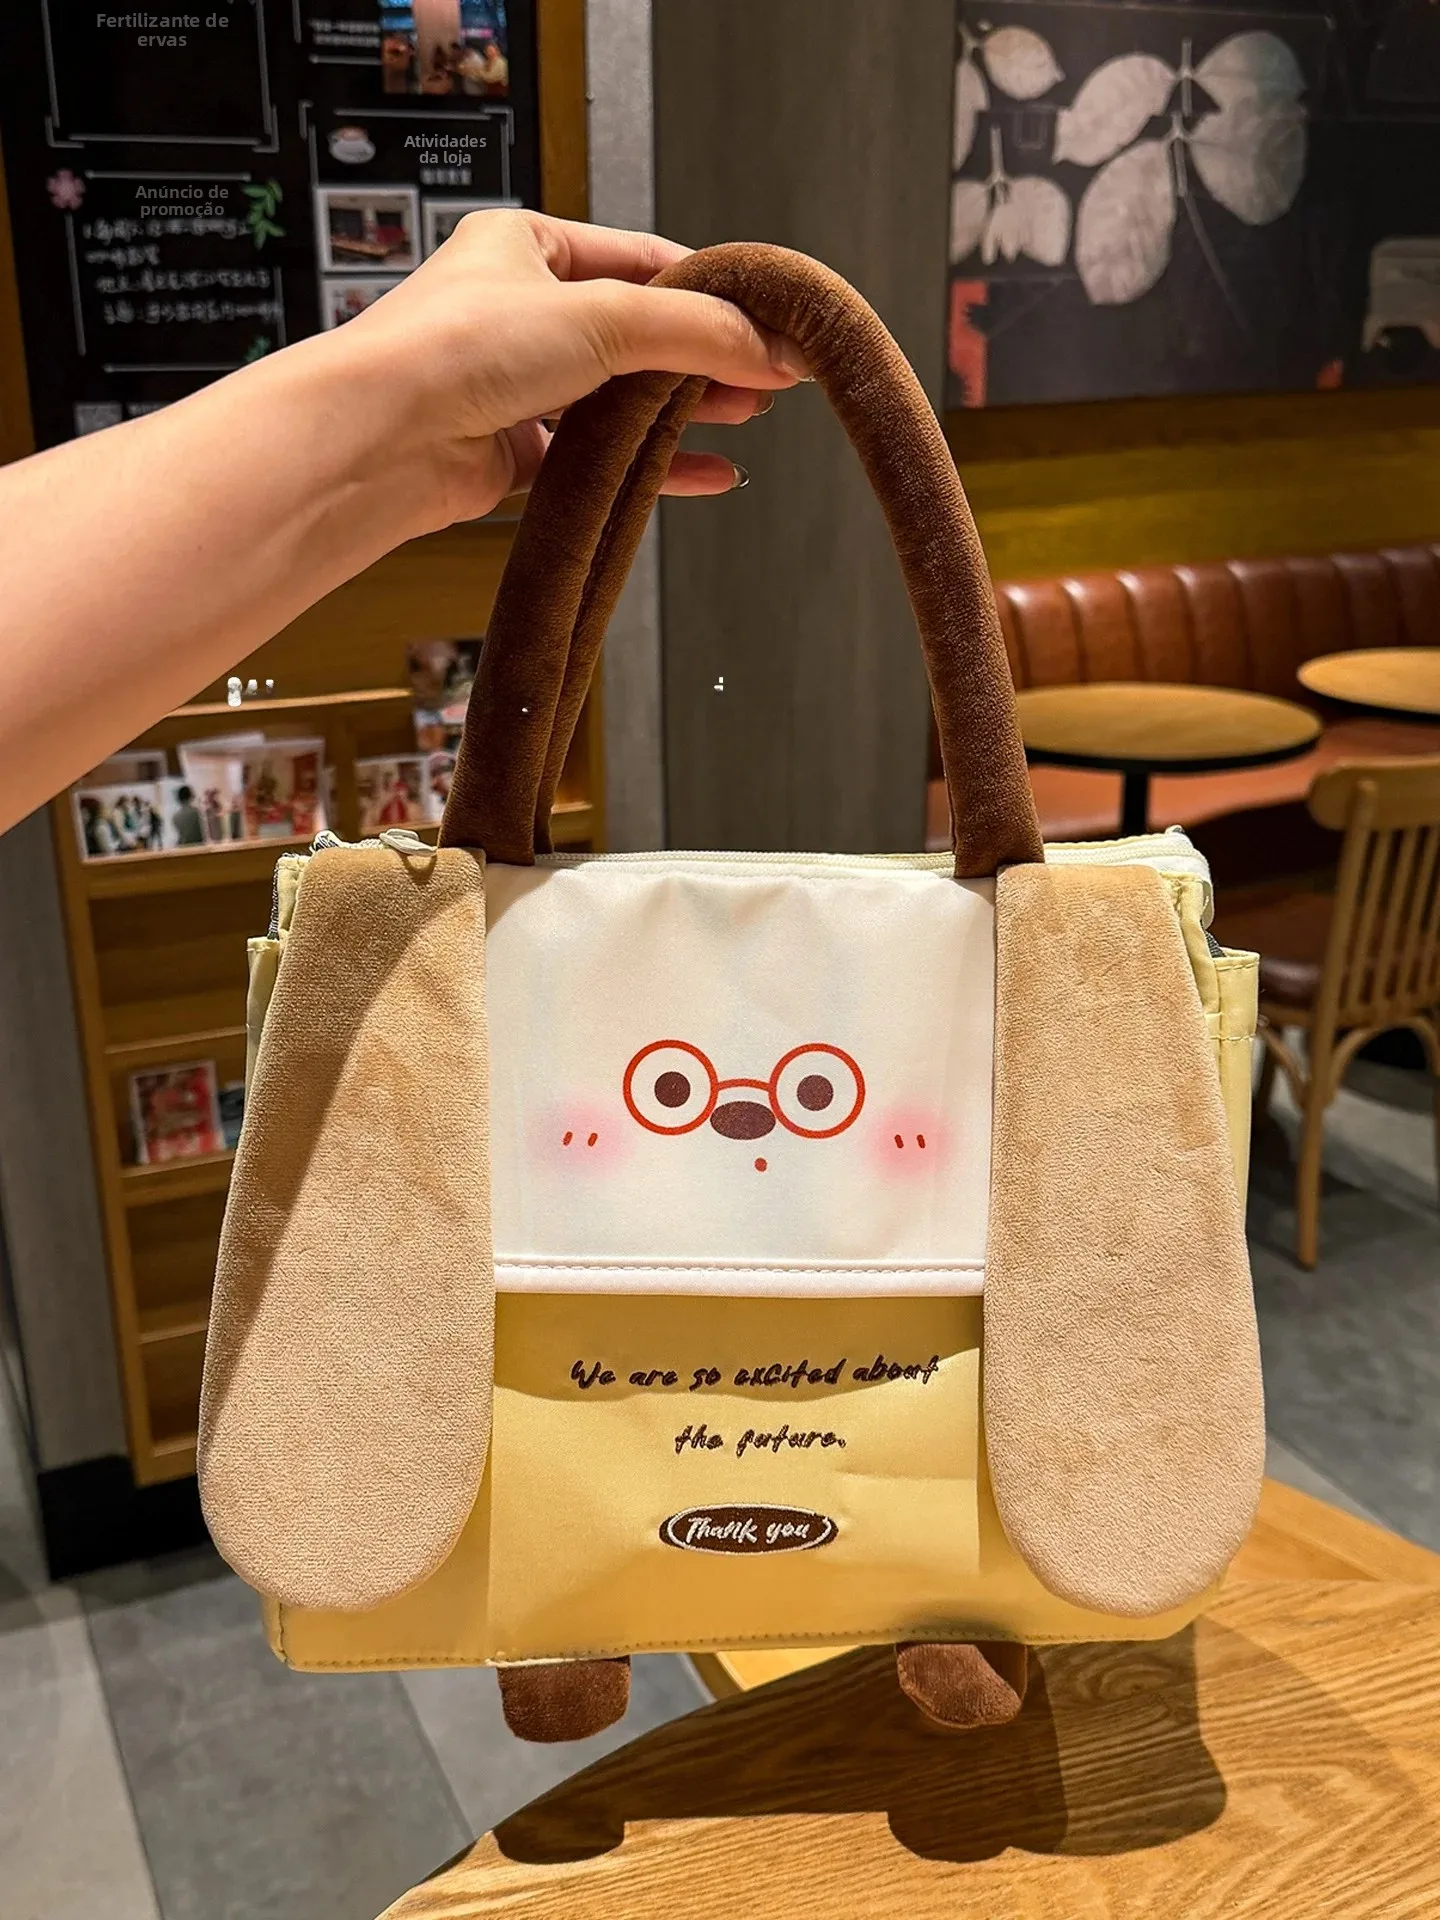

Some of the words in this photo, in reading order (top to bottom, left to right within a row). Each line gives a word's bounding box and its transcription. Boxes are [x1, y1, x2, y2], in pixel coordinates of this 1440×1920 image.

[571, 1359, 617, 1389] We
[628, 1371, 679, 1387] are
[688, 1367, 722, 1391] so
[852, 1354, 939, 1384] about
[674, 1424, 724, 1454] the
[685, 1515, 757, 1545] Thank
[765, 1522, 810, 1545] you
